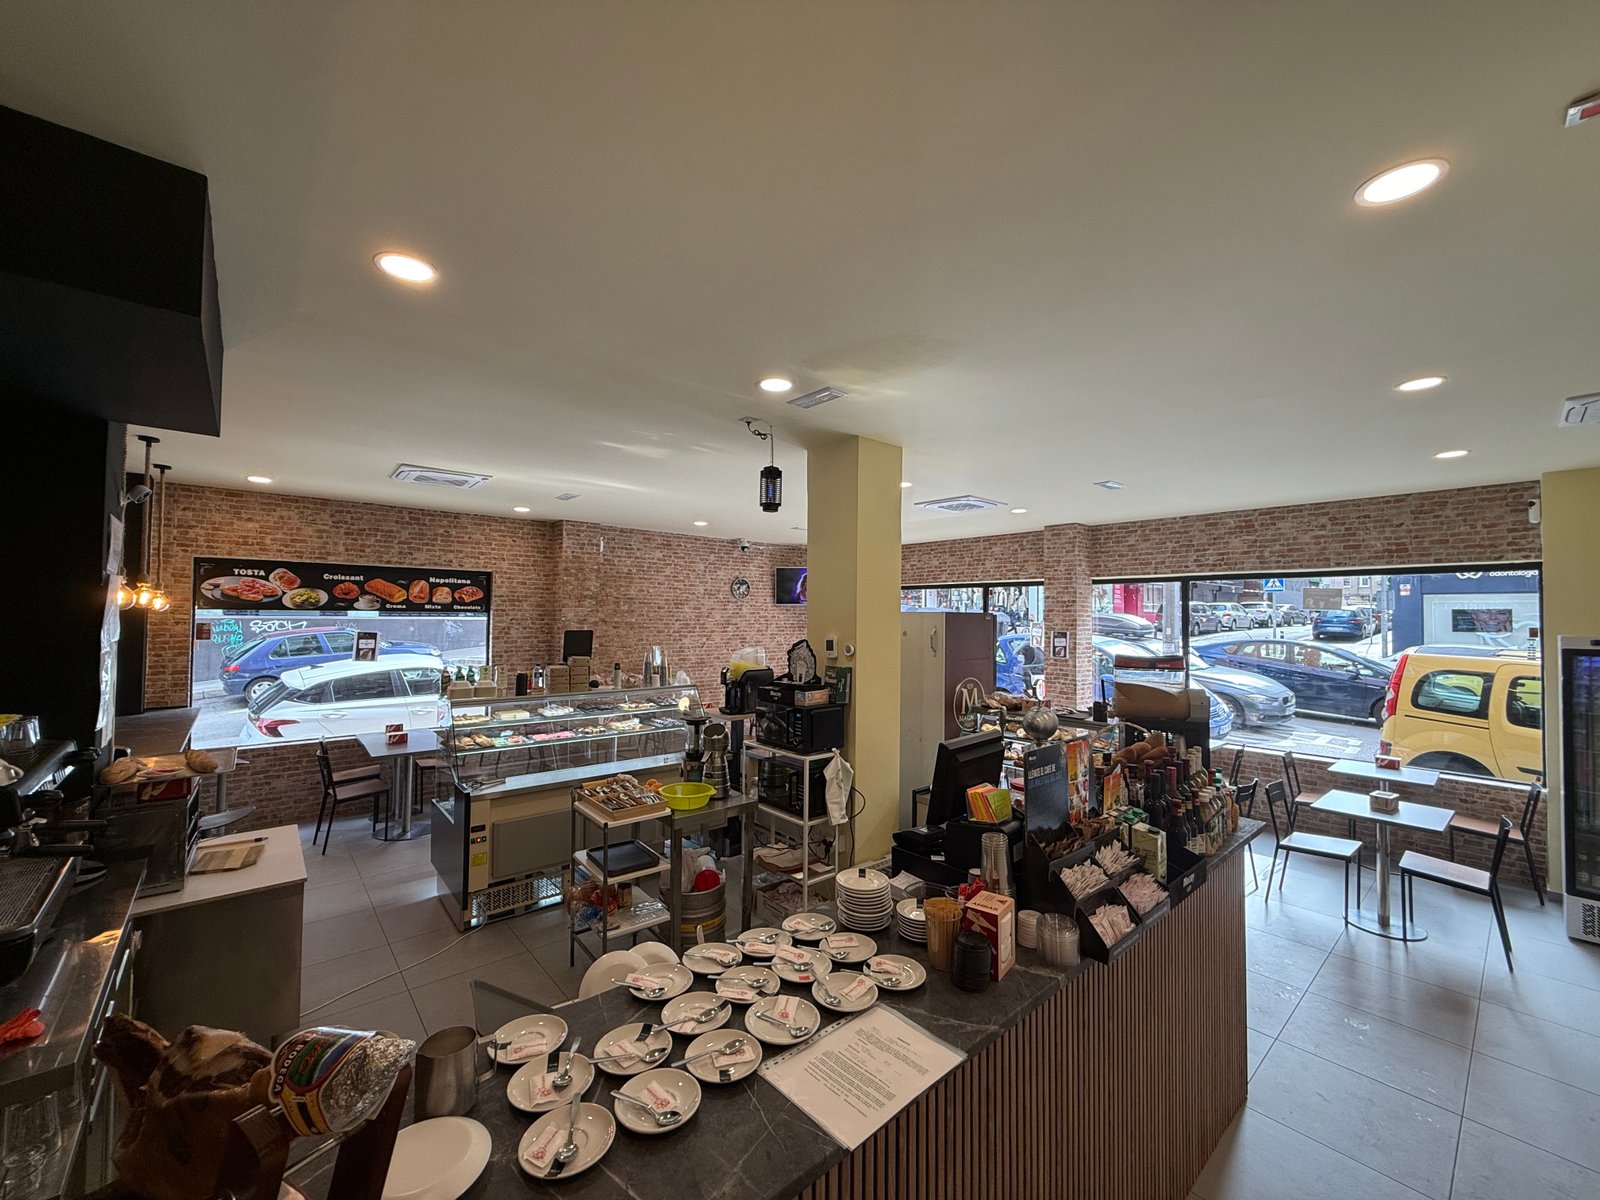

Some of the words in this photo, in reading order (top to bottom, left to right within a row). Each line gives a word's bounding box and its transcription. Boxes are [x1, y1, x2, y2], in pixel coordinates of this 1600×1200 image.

[232, 568, 266, 576] TOSTA
[323, 573, 364, 581] Croissant
[429, 576, 471, 585] Napolitana
[273, 1044, 304, 1092] BODEGA
